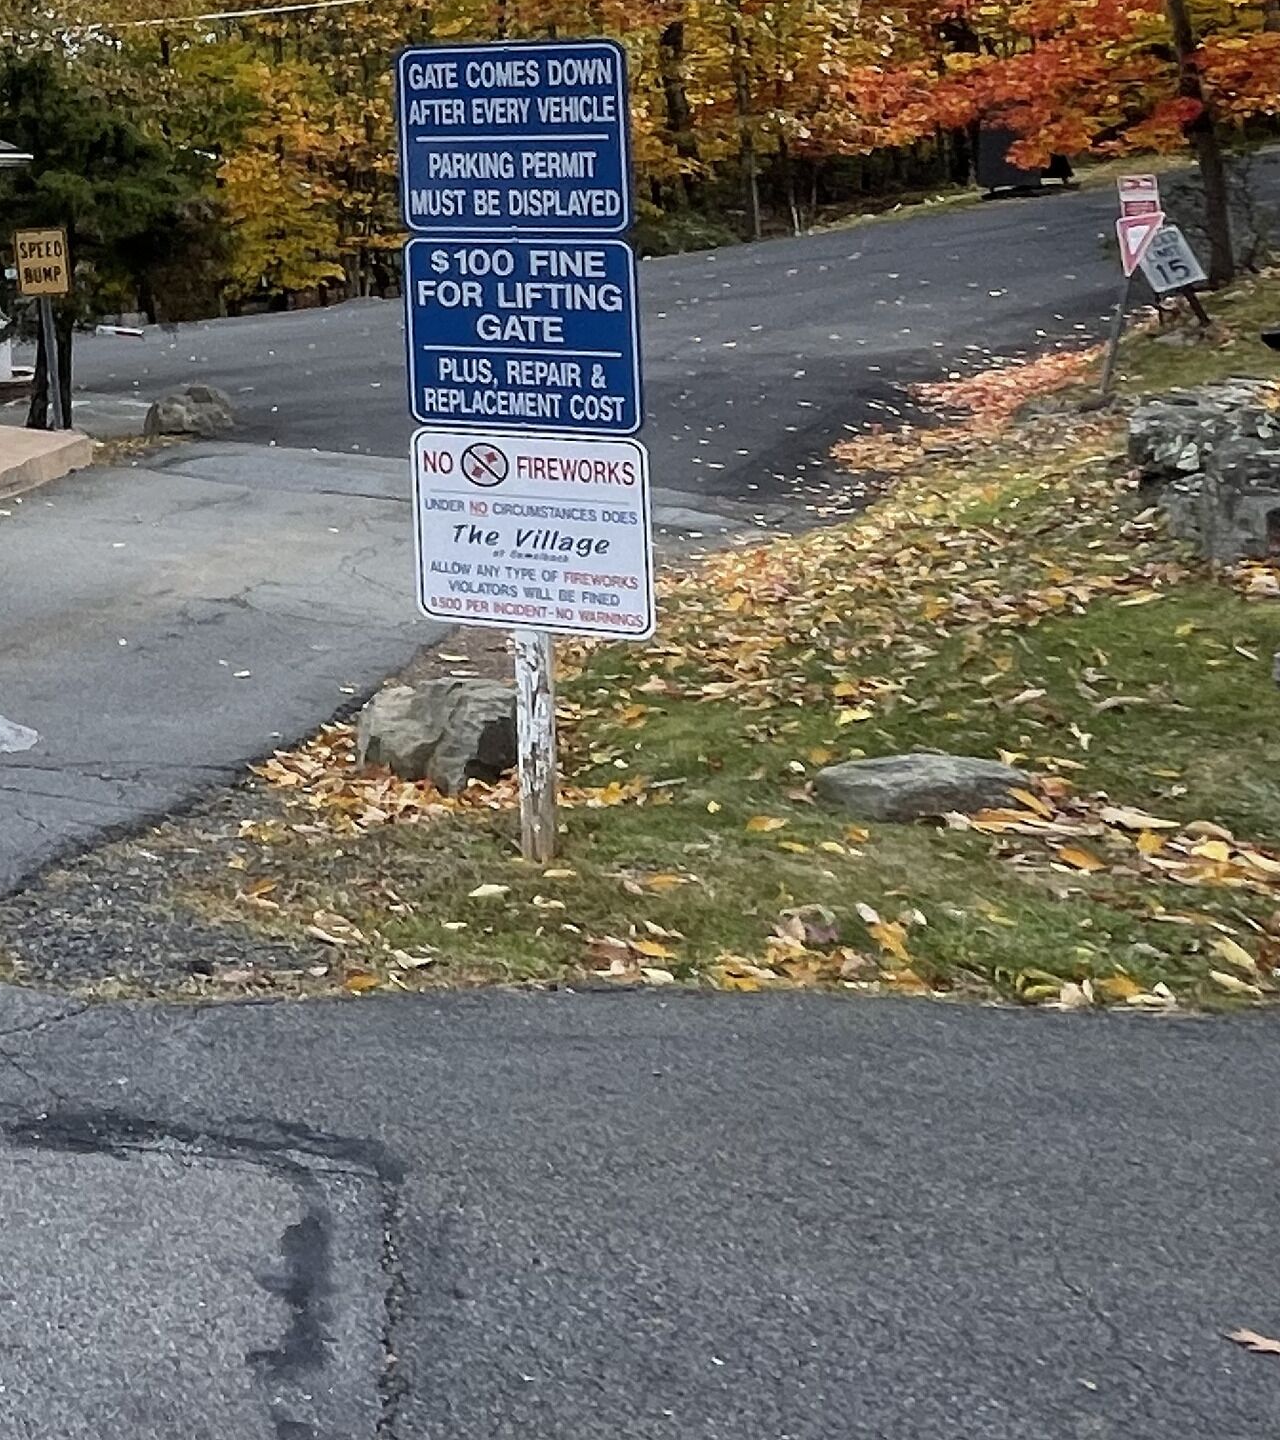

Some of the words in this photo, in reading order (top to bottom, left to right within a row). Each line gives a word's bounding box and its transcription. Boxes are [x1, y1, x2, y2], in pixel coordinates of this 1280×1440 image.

[408, 62, 458, 90] GATE
[465, 61, 540, 88] COMES
[548, 58, 613, 85] DOWN
[408, 98, 465, 125] AFTER
[472, 97, 529, 124] EVERY
[538, 96, 616, 123] VEHICLE
[428, 152, 514, 179] PARKING
[522, 151, 597, 178] PERMIT
[411, 190, 466, 216] MUST
[474, 190, 501, 216] BE
[509, 190, 621, 217] DISPLAYED
[19, 241, 62, 259] SPEED
[430, 248, 514, 276] $100
[529, 250, 606, 278] FINE
[23, 266, 61, 284] BUMP
[1156, 259, 1190, 285] 15
[417, 281, 482, 308] FOR
[497, 283, 623, 312] LIFTING
[476, 314, 564, 343] GATE
[439, 358, 498, 387] PLUS,
[506, 361, 581, 388] REPAIR
[591, 364, 606, 389] &
[424, 388, 561, 420] REPLACEMENT
[569, 395, 625, 422] COST
[423, 450, 454, 474] NO
[516, 456, 636, 486] FIREWORKS
[424, 498, 465, 513] UNDER
[469, 501, 488, 515] NO
[492, 501, 598, 522] CIRCUMSTANCES
[602, 510, 638, 525] DOES
[453, 524, 500, 546] The
[516, 528, 611, 557] Village
[430, 560, 472, 575] ALLOW
[477, 564, 501, 578] ANY
[504, 566, 537, 581] TYPE
[541, 569, 558, 583] OF
[563, 571, 638, 590] FIREWORKS
[448, 580, 518, 598] VIOLATORS
[523, 586, 554, 602] WILL
[558, 589, 576, 604] BE
[582, 591, 620, 607] FINED
[466, 599, 489, 613] PER
[579, 610, 644, 628] WARNINGS
